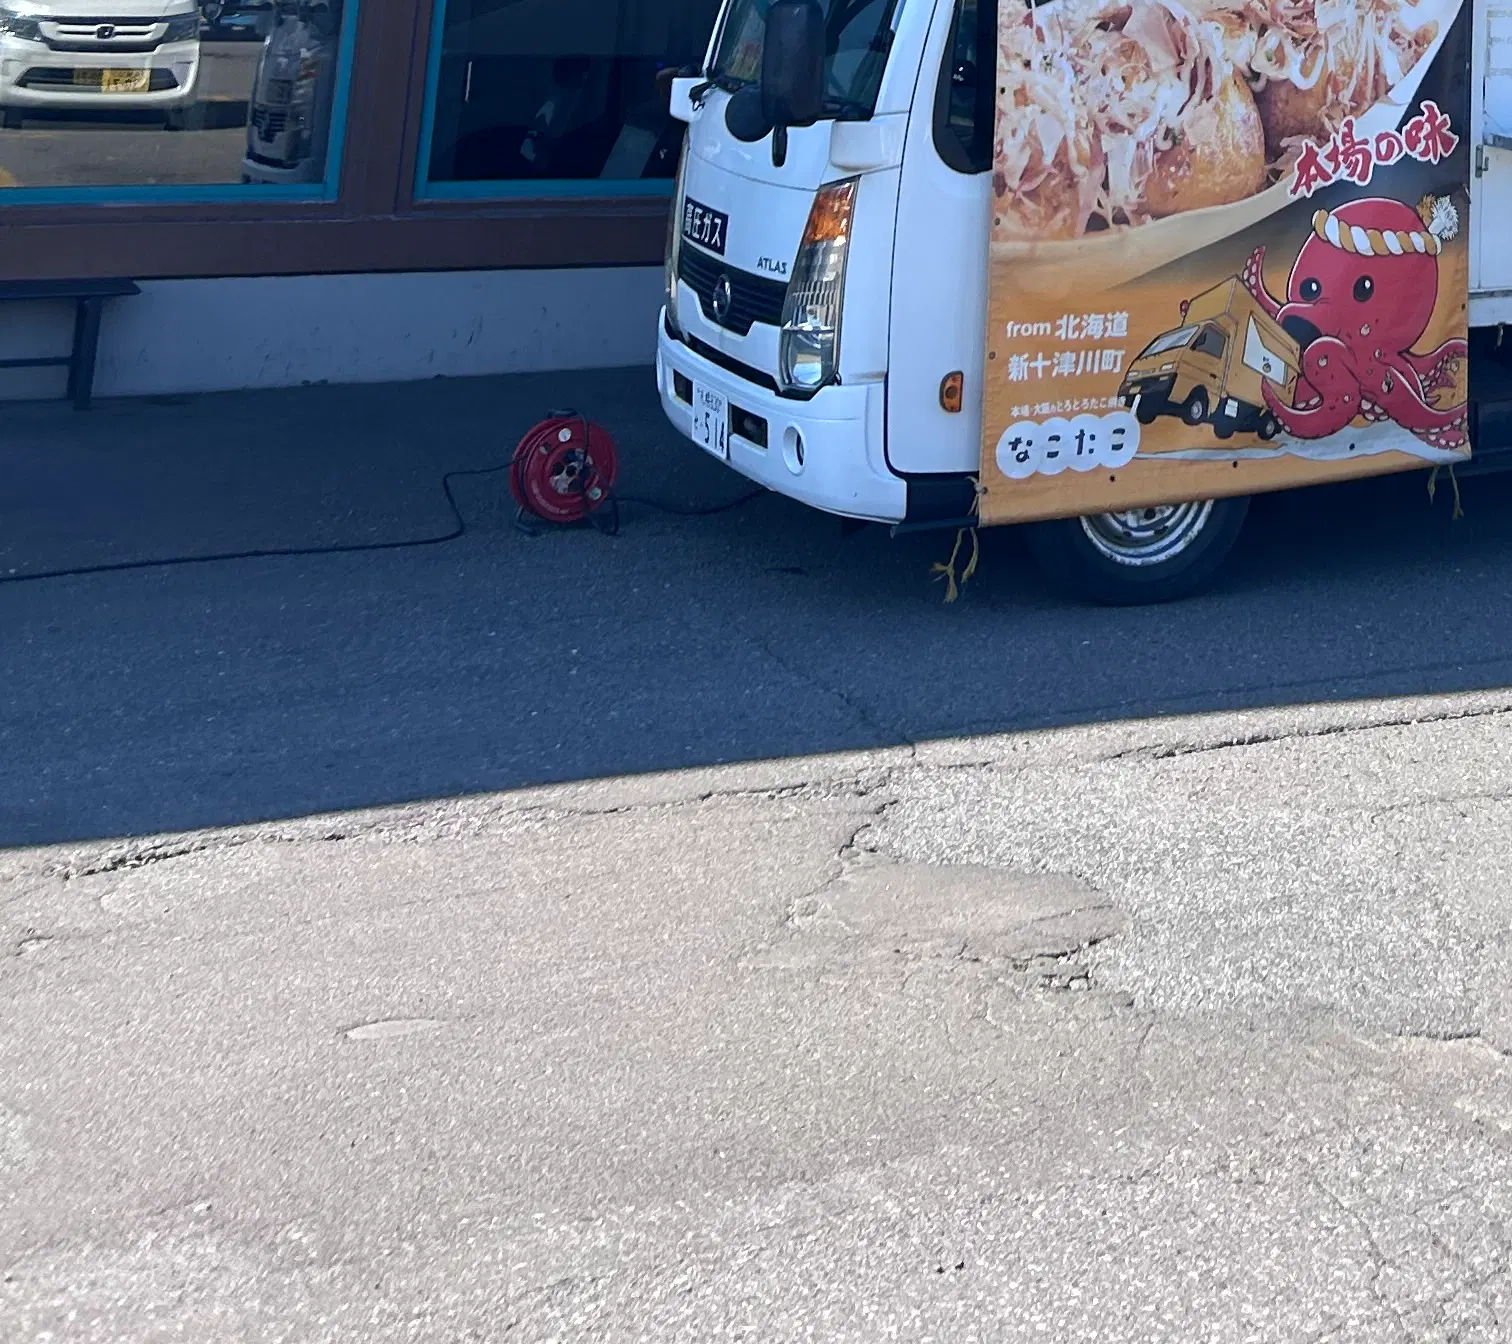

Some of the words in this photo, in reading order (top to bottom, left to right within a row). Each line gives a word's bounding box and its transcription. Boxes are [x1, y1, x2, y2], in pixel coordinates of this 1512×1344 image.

[1287, 100, 1460, 198] 本場の味
[684, 202, 722, 248] 高圧ガス
[756, 255, 788, 275] ATLAS
[1006, 319, 1052, 338] from
[1055, 311, 1129, 341] 北海道
[1007, 348, 1126, 383] 新十津川町
[1007, 427, 1127, 464] なこたこ
